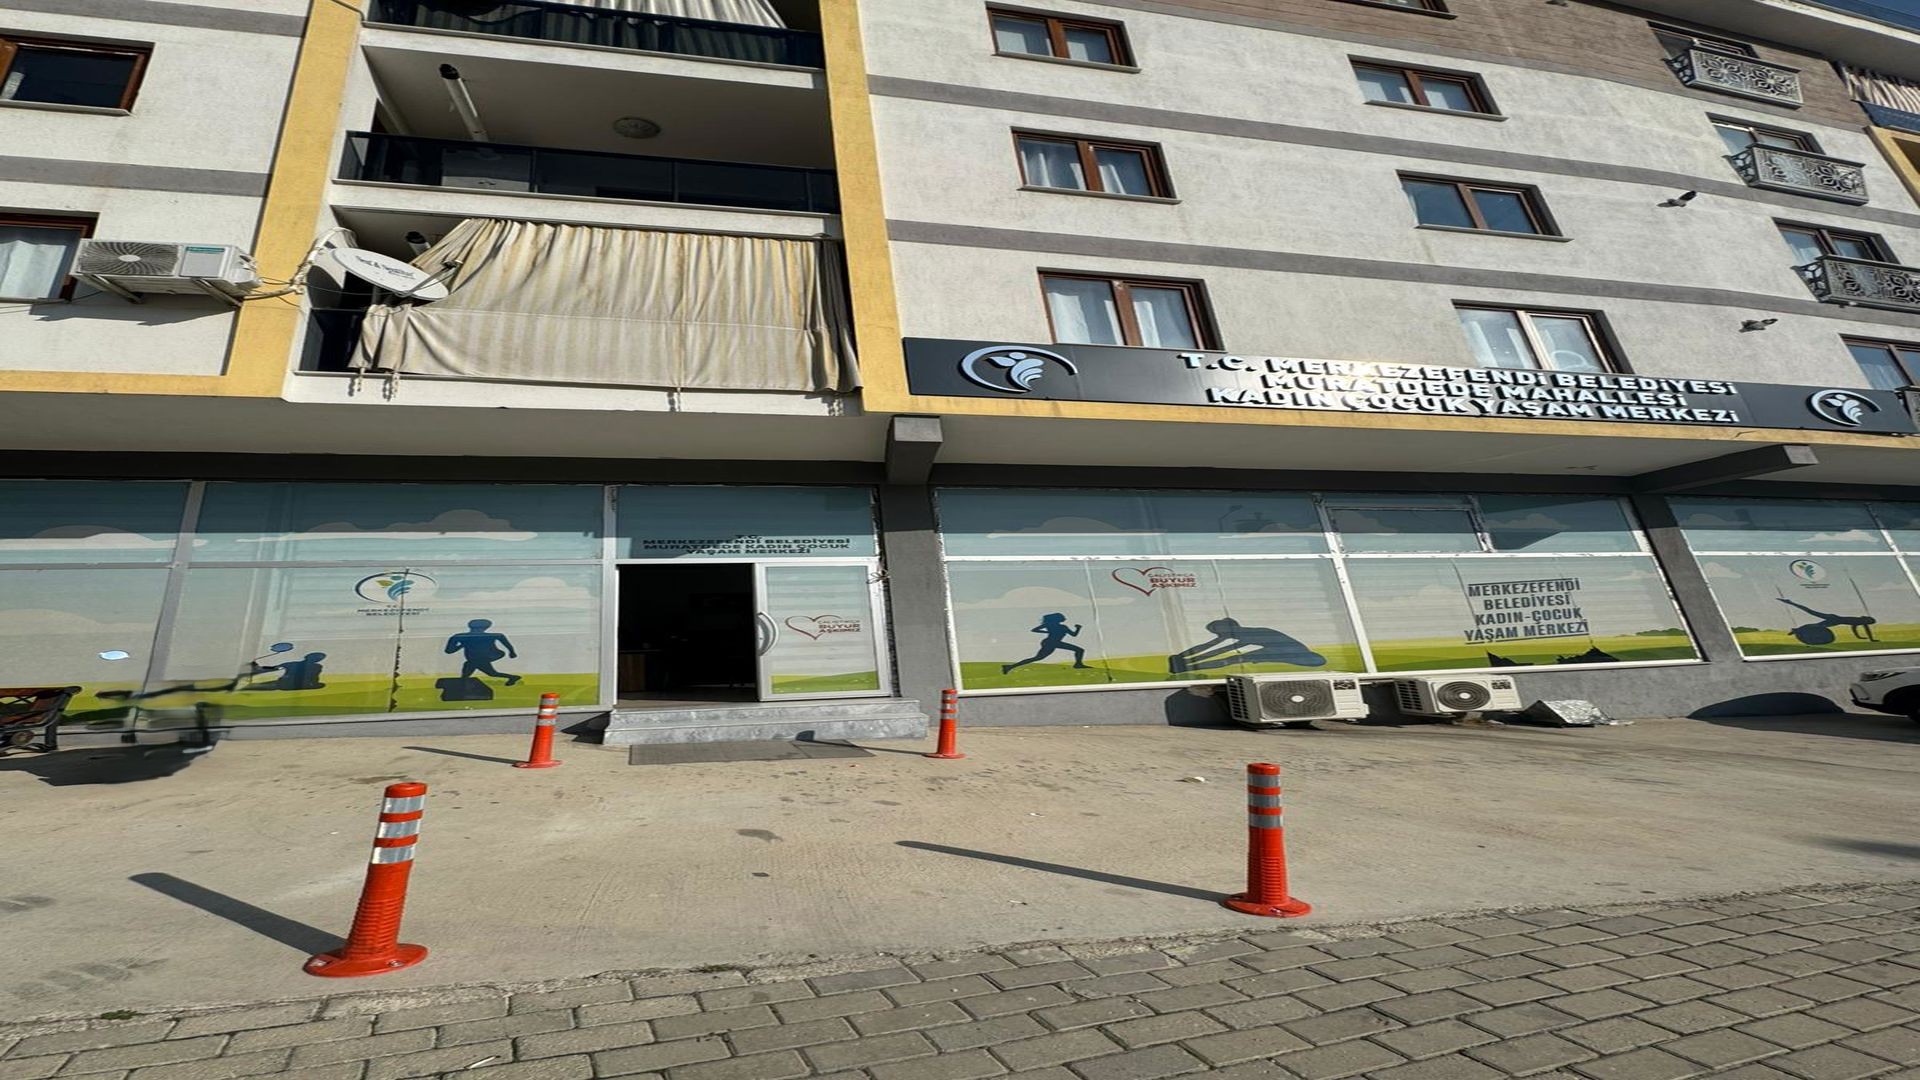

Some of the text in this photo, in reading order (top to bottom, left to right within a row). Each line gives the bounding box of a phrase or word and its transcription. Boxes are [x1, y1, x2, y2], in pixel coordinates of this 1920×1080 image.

[1177, 352, 1257, 372] T.C.
[1260, 374, 1493, 398] MURATDEDE
[1206, 387, 1333, 407] KADIN
[1341, 394, 1470, 413] ÇOCUK
[1471, 399, 1594, 417] YAŞAM
[1468, 578, 1581, 597] MERKEZEFENDİ
[1484, 592, 1570, 611] BELEDİYESİ
[1475, 607, 1583, 626] KADIN-ÇOCUK
[1464, 619, 1589, 642] YAŞAM MERKEZİ
